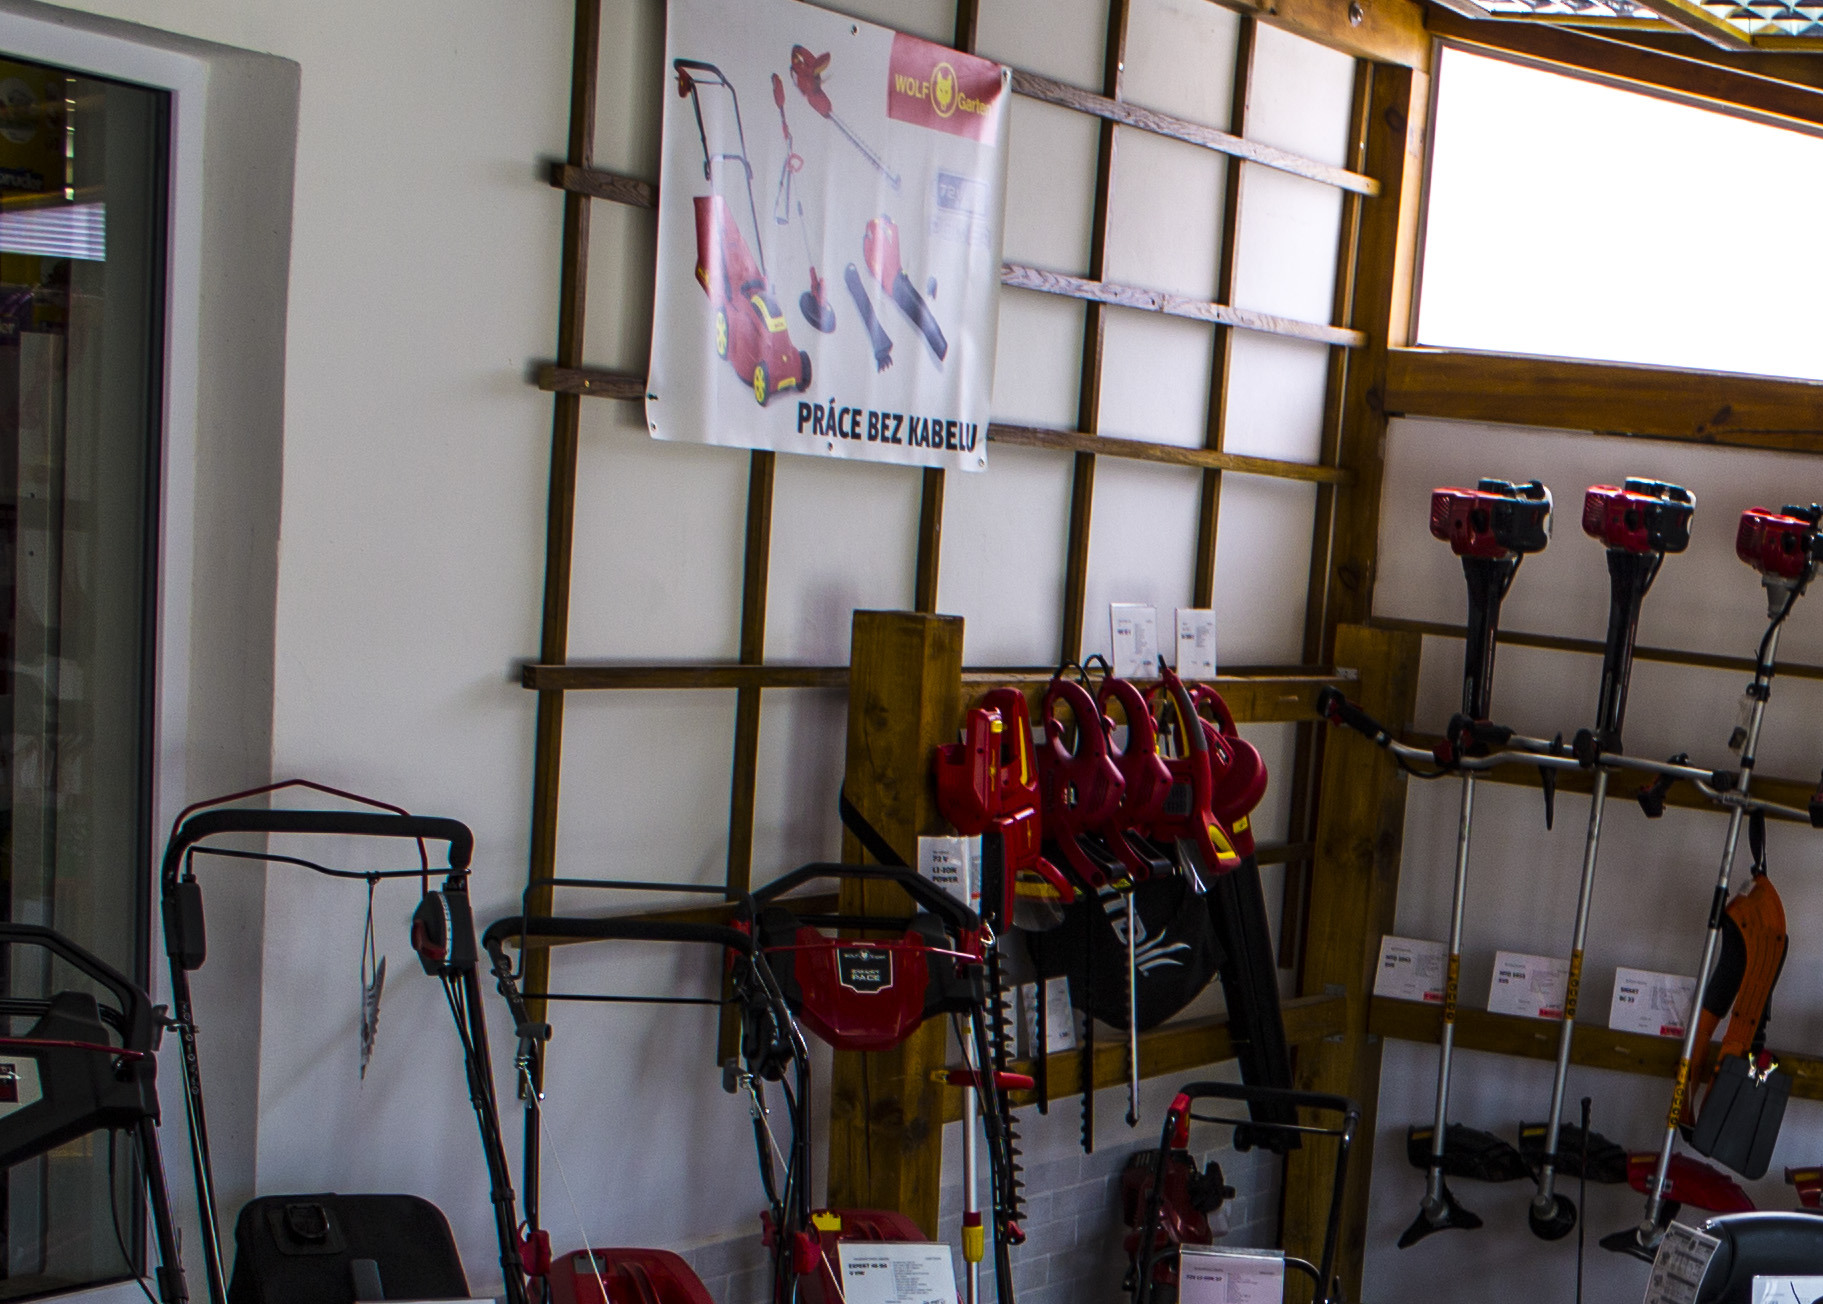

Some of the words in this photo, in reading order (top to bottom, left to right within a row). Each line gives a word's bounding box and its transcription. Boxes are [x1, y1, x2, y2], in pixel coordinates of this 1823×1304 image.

[894, 73, 929, 99] WOLF
[957, 92, 992, 117] Garten
[798, 397, 862, 440] PRÁCE
[867, 410, 904, 445] BEZ
[908, 415, 978, 453] KABELU
